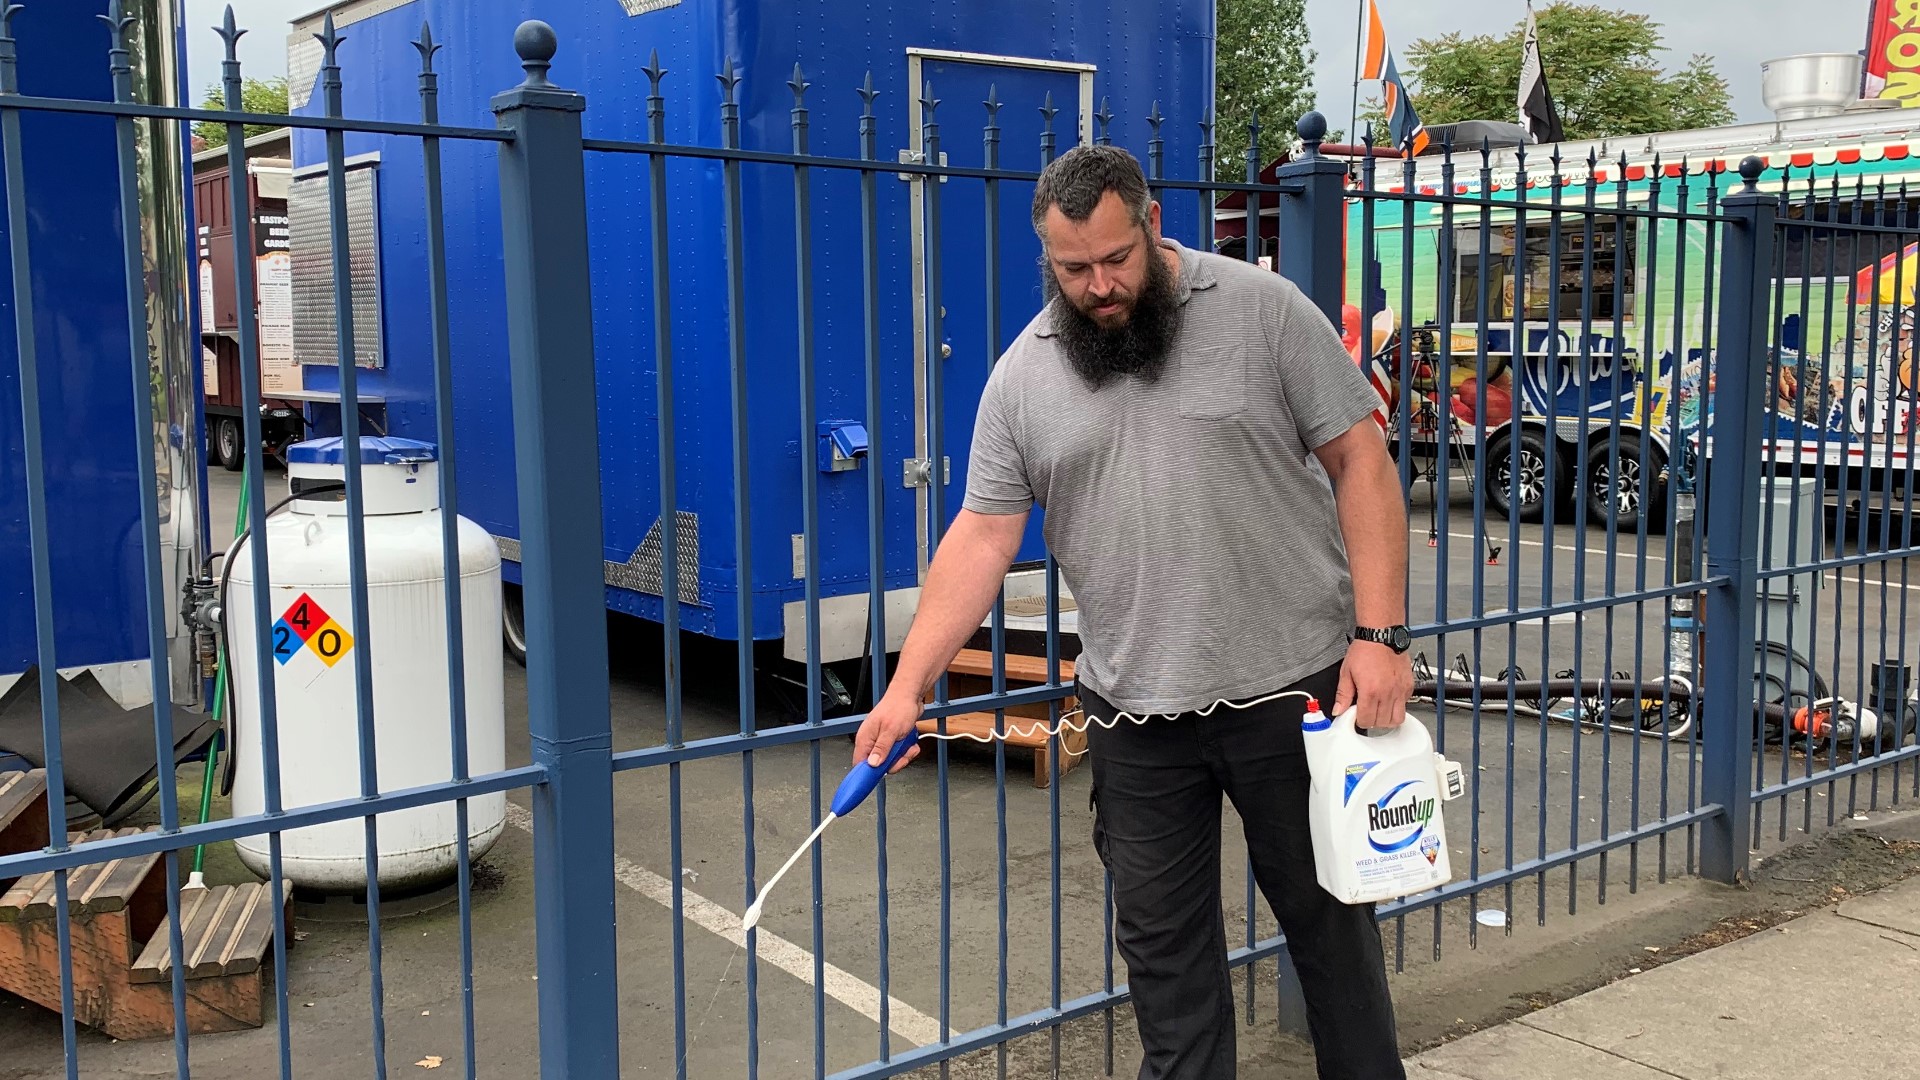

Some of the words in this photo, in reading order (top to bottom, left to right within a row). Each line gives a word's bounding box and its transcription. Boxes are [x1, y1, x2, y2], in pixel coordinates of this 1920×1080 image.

[291, 602, 311, 631] 4
[274, 626, 291, 655] 2
[317, 628, 342, 657] 0
[1367, 794, 1435, 832] Roundup
[1355, 858, 1373, 867] WEED
[1379, 853, 1399, 863] GRASS
[1399, 850, 1417, 859] KILLER
